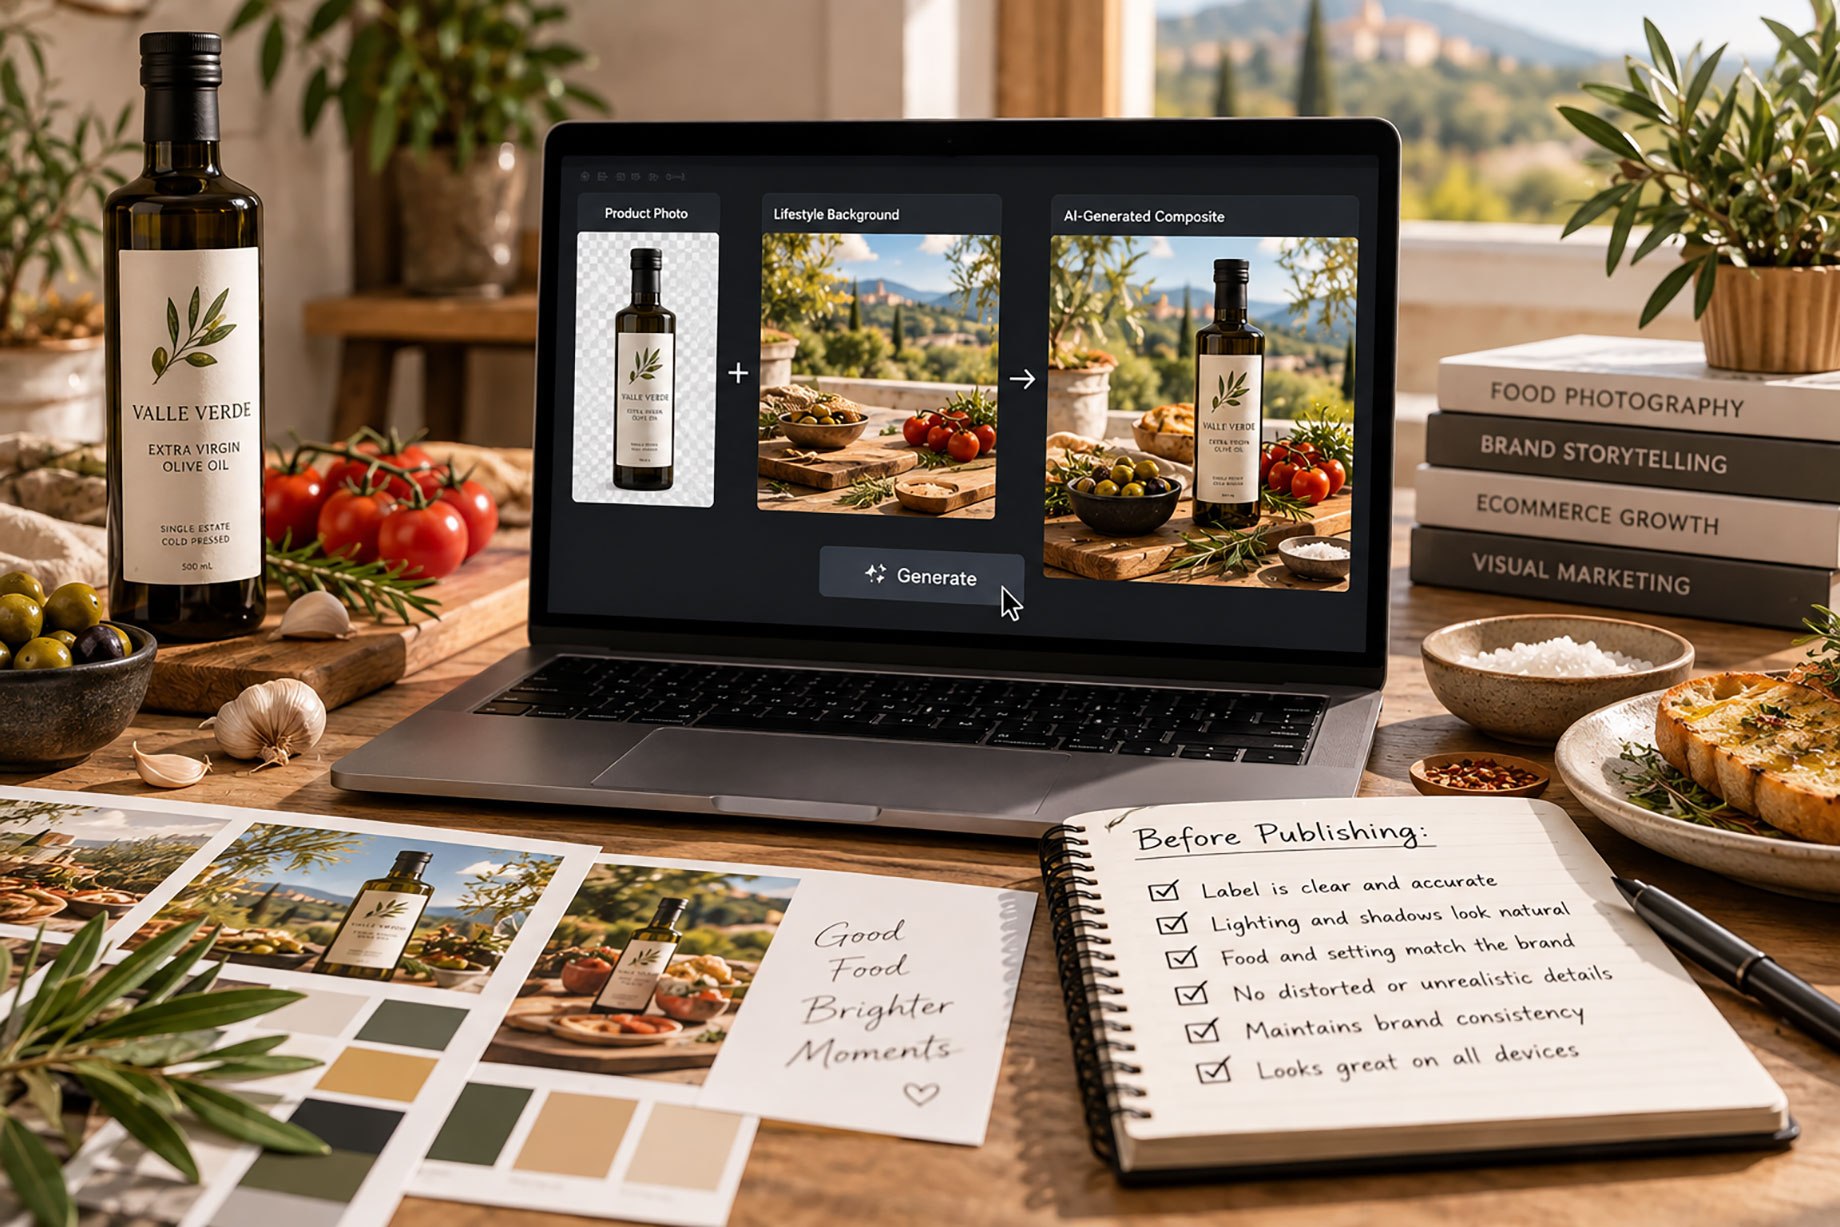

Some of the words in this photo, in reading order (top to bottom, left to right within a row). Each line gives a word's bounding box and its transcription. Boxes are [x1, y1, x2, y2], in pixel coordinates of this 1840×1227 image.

[605, 207, 651, 220] Product
[653, 207, 689, 220] Photo
[773, 208, 824, 222] Lifestyle
[827, 208, 900, 223] Background
[1064, 210, 1151, 223] AI-Generated
[1154, 210, 1225, 225] Composite
[132, 404, 189, 422] VALLE
[195, 402, 251, 420] VERDE
[1490, 381, 1556, 404] FOOD
[1565, 387, 1745, 418] PHOTOGRAPHY
[148, 443, 192, 456] EXTRA
[196, 441, 241, 455] VIRGIN
[1481, 434, 1556, 459] BRAND
[1563, 441, 1727, 474] STORYTELLING
[162, 460, 203, 473] OLIVE
[207, 459, 229, 472] OIL
[160, 524, 195, 533] SINGLE
[198, 522, 231, 532] ESTATE
[1476, 493, 1612, 524] ECOMMERCE
[1619, 508, 1719, 536] GROWTH
[161, 537, 188, 546] COLD
[191, 535, 230, 545] PRESSED
[181, 563, 198, 571] 500
[897, 567, 977, 587] Generate
[1472, 552, 1549, 579] VISUAL
[1557, 562, 1691, 596] MARKETING
[1132, 825, 1241, 853] Before
[1254, 820, 1428, 850] Publishing:
[1201, 881, 1260, 899] Label
[1272, 882, 1289, 896] is
[1301, 878, 1352, 894] clear
[1363, 875, 1401, 891] and
[1411, 873, 1499, 890] accurate
[814, 919, 905, 948] Good
[1211, 914, 1301, 937] Lighting
[1311, 910, 1349, 927] and
[1359, 908, 1443, 925] shadows
[1450, 904, 1492, 920] look
[1500, 901, 1571, 918] natural
[1221, 948, 1269, 966] Food
[1280, 946, 1318, 962] and
[1327, 945, 1396, 963] setting
[1405, 938, 1466, 956] match
[1474, 937, 1509, 952] the
[1514, 933, 1575, 950] brand
[828, 953, 911, 982] Food
[1233, 985, 1265, 1002] No
[1278, 978, 1376, 1000] distorted
[1387, 981, 1408, 993] or
[1420, 970, 1533, 990] unrealistic
[1544, 964, 1613, 984] details
[801, 993, 955, 1032] Brighter
[1246, 1020, 1362, 1040] Maintains
[1374, 1010, 1443, 1031] brand
[1456, 1005, 1585, 1026] consistency
[785, 1034, 961, 1069] Moments
[1257, 1059, 1323, 1080] Looks
[1337, 1053, 1398, 1083] great
[1412, 1055, 1440, 1069] on
[1453, 1047, 1481, 1065] all
[1495, 1044, 1580, 1063] devices
